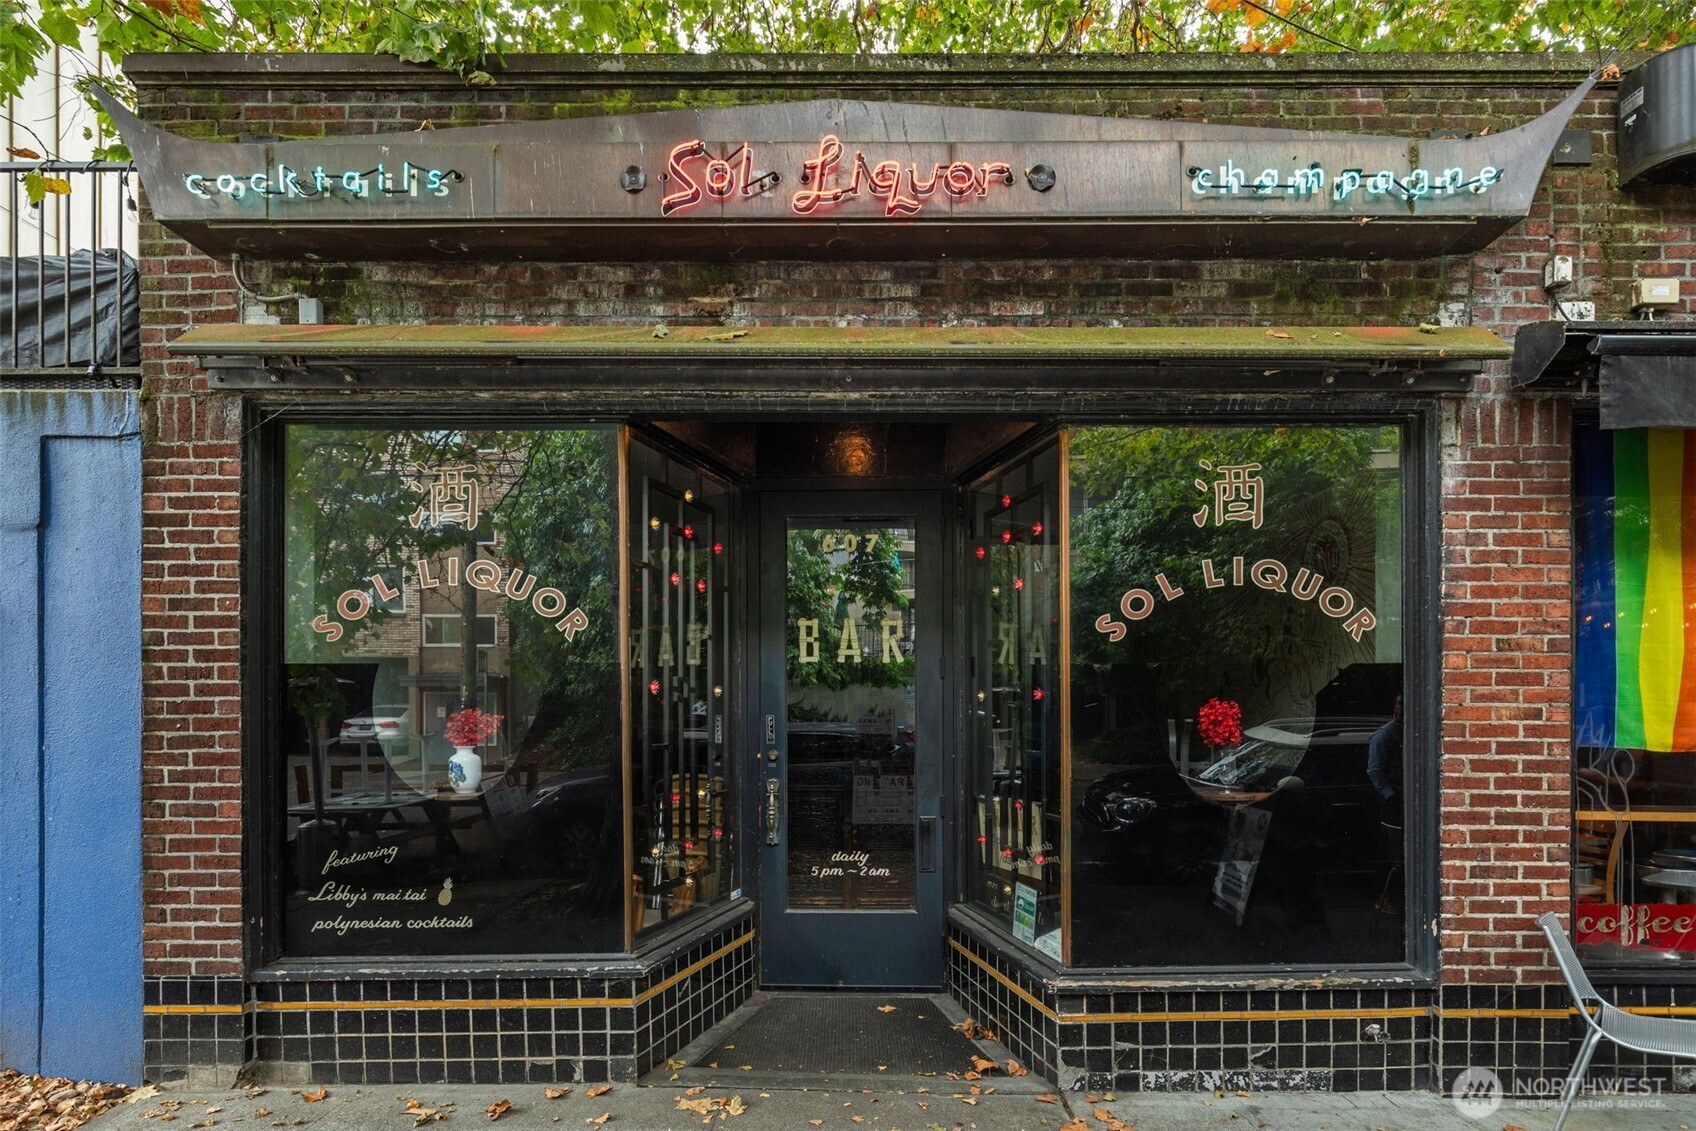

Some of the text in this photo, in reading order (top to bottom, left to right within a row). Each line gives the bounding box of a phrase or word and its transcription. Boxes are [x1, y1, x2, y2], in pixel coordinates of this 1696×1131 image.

[185, 162, 452, 198] cocktails
[661, 134, 1010, 216] Sol Liquor
[1191, 159, 1500, 201] champagne
[408, 462, 479, 531] 酒
[1193, 459, 1264, 529] 酒
[822, 534, 878, 552] 607
[312, 557, 589, 642] SOL LIQUOR
[1095, 556, 1376, 643] SOL LIQUOR
[797, 618, 904, 663] BAR
[322, 845, 398, 875] featuring
[831, 851, 869, 867] daily
[308, 881, 366, 908] Libby's
[311, 915, 473, 936] polynesian cocktails
[1577, 905, 1694, 947] coffee
